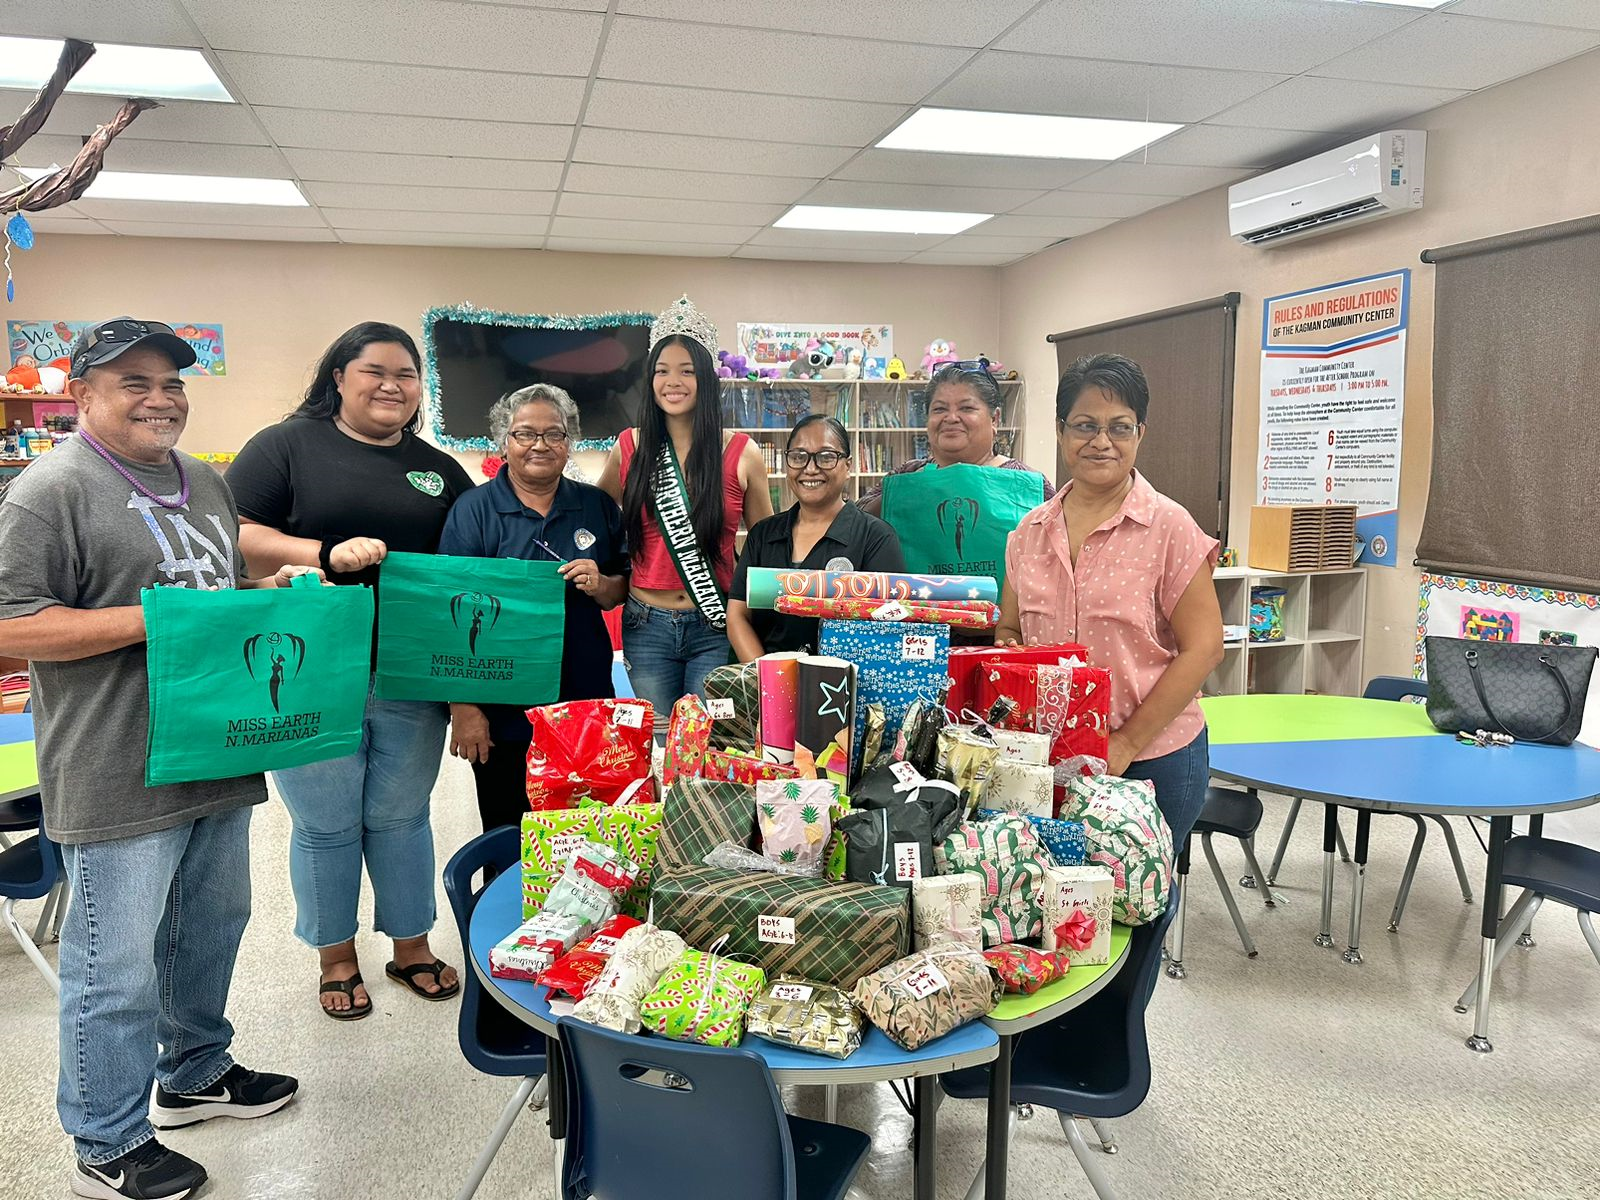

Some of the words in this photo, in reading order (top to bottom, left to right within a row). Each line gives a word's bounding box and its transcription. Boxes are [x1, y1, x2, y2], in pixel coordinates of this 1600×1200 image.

[1275, 306, 1303, 324] RULES
[1305, 303, 1324, 319] AND
[1327, 288, 1398, 315] REGULATIONS
[1273, 326, 1281, 338] OF
[1282, 323, 1294, 336] THE
[1295, 320, 1321, 334] KAGMAN
[1323, 313, 1364, 329] COMMUNITY
[1365, 308, 1395, 322] CENTER
[21, 327, 53, 345] We
[1328, 430, 1334, 446] 6
[1264, 455, 1270, 469] 2
[1327, 454, 1333, 470] 7
[1263, 476, 1268, 490] 3
[1326, 476, 1332, 492] 8
[653, 465, 697, 551] NORTHERN
[677, 548, 727, 624] MARIANAS
[928, 564, 954, 575] MISS
[958, 561, 997, 573] EARTH
[906, 648, 925, 656] 7-12
[432, 654, 464, 667] MISS
[468, 658, 514, 670] EARTH
[227, 718, 267, 733] MISS
[272, 712, 322, 729] EARTH
[224, 727, 319, 748] N.MARIANAS
[604, 744, 628, 757] Merry
[1060, 886, 1074, 895] Ages
[761, 919, 781, 927] BOYS
